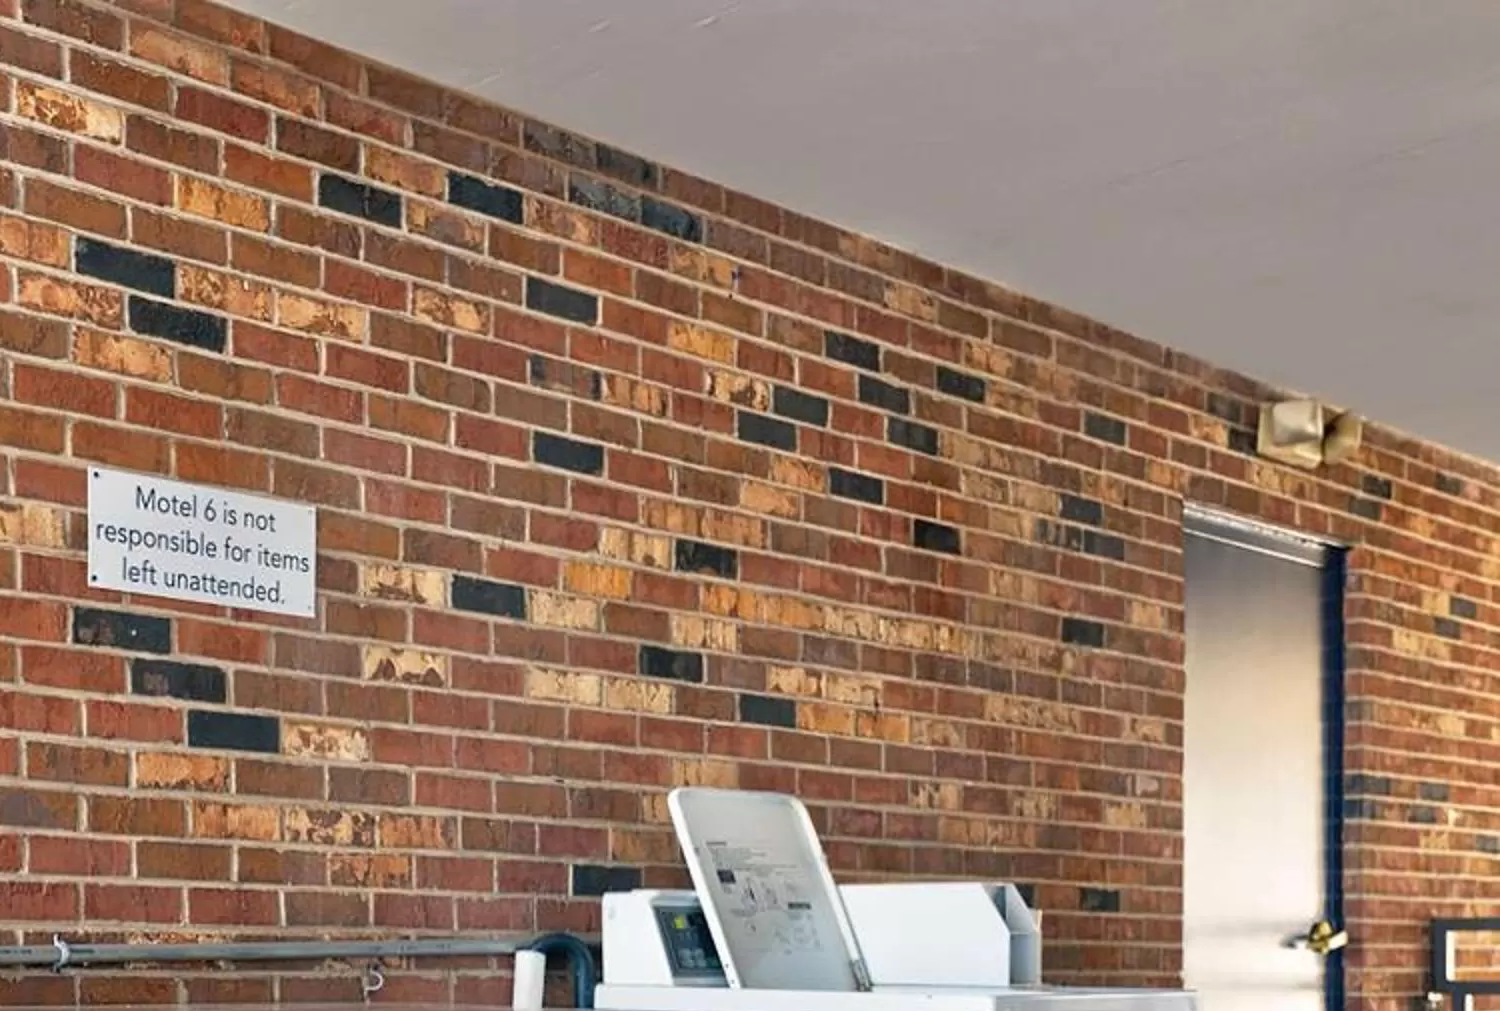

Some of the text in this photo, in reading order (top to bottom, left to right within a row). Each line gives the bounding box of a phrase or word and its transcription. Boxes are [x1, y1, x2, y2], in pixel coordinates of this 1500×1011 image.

[135, 485, 276, 533] Motel 6 is not
[96, 522, 310, 573] responsible for items
[122, 556, 286, 605] left unattended.
